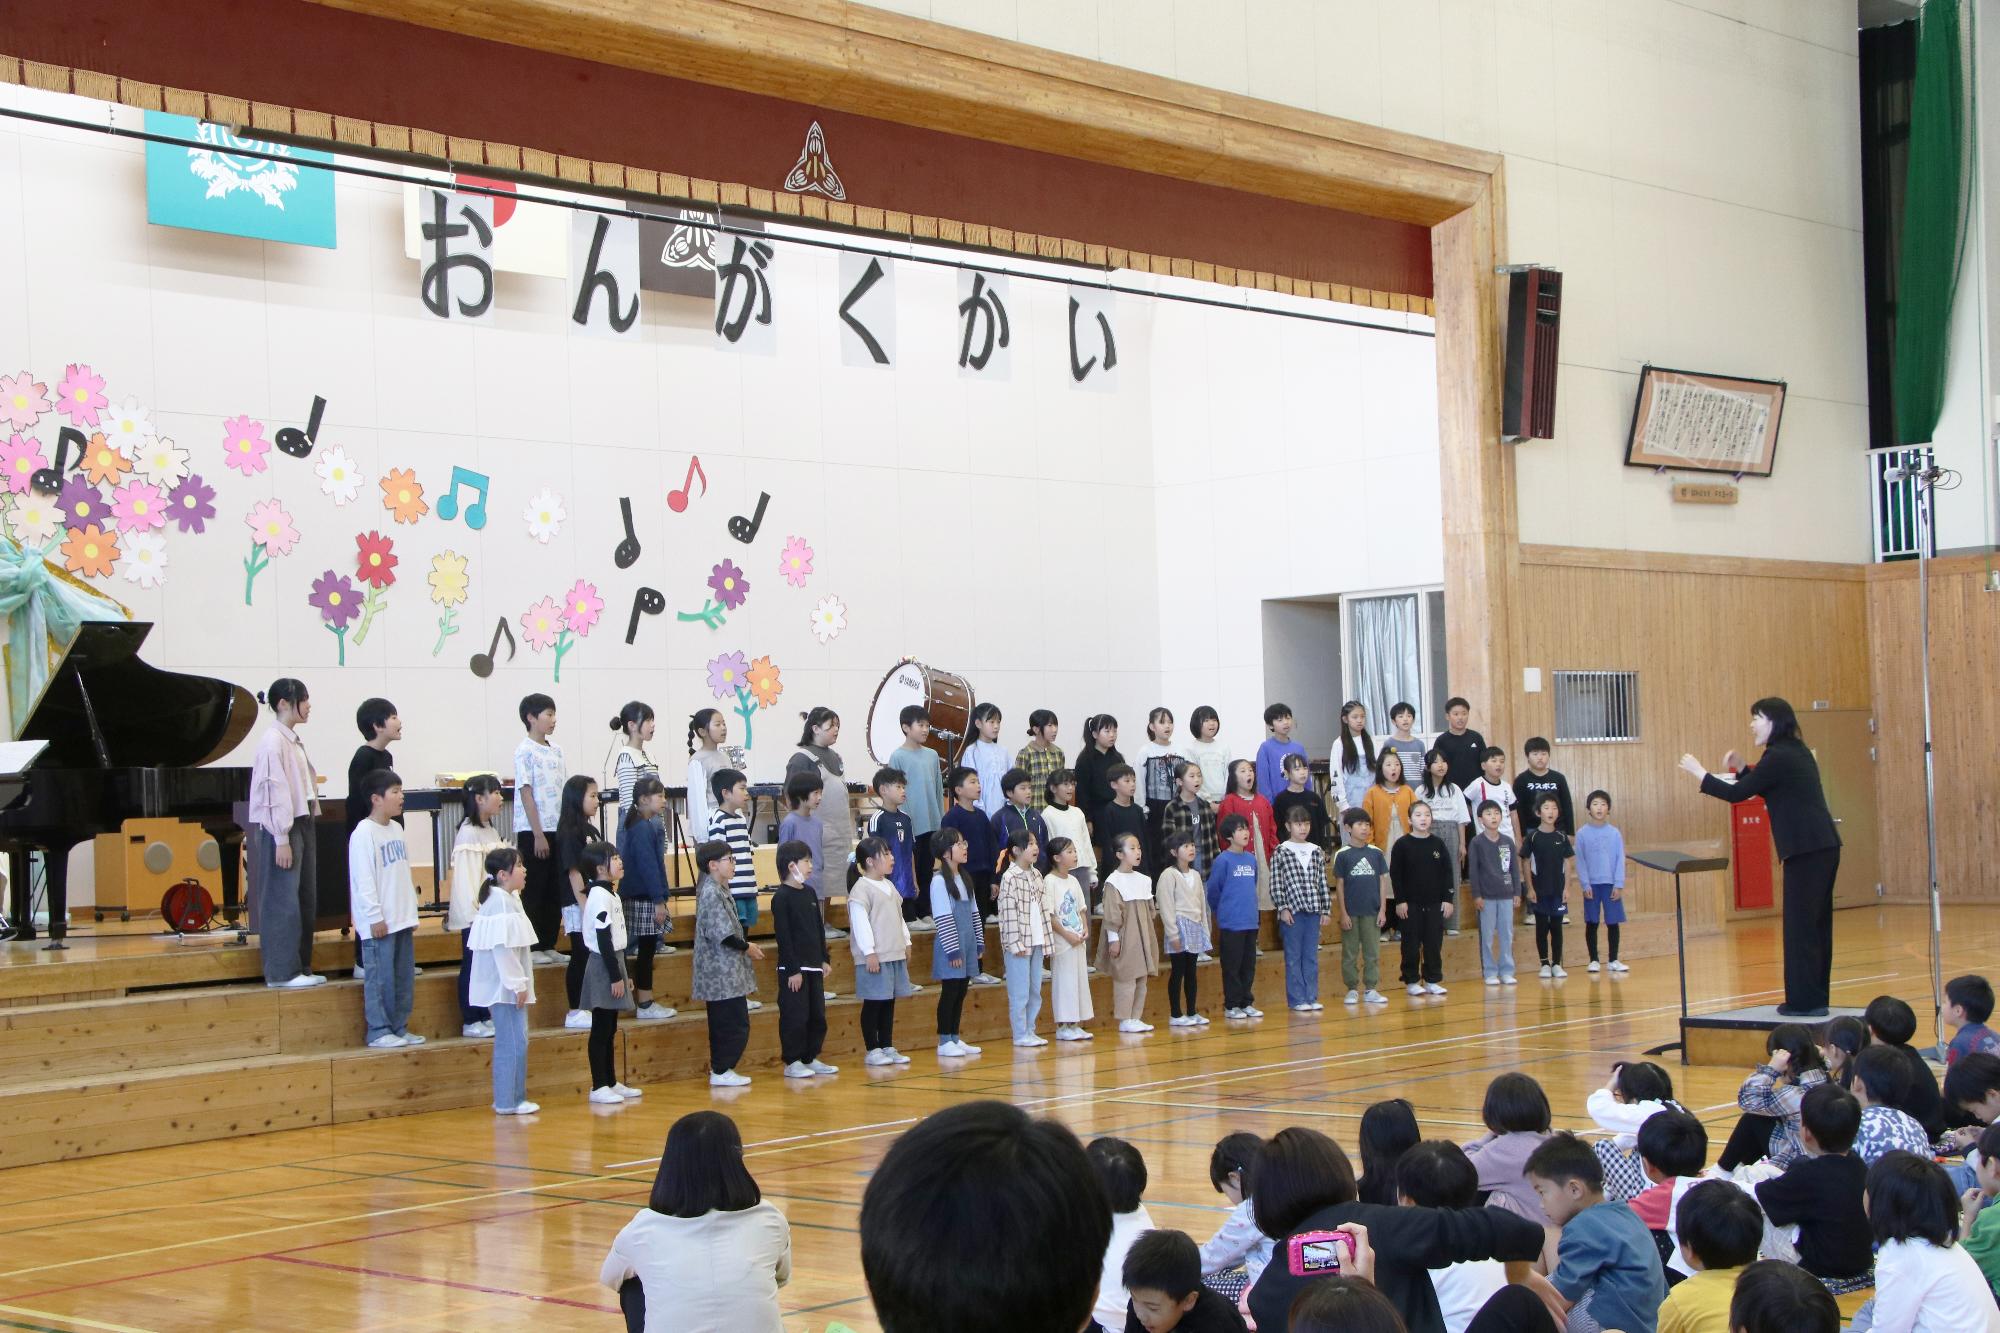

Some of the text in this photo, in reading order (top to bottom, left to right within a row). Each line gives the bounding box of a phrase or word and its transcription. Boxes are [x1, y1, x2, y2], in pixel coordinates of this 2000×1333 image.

[421, 190, 1117, 383] おんがくかい
[904, 677, 921, 690] YAMAHA
[1527, 782, 1558, 790] ラスボス
